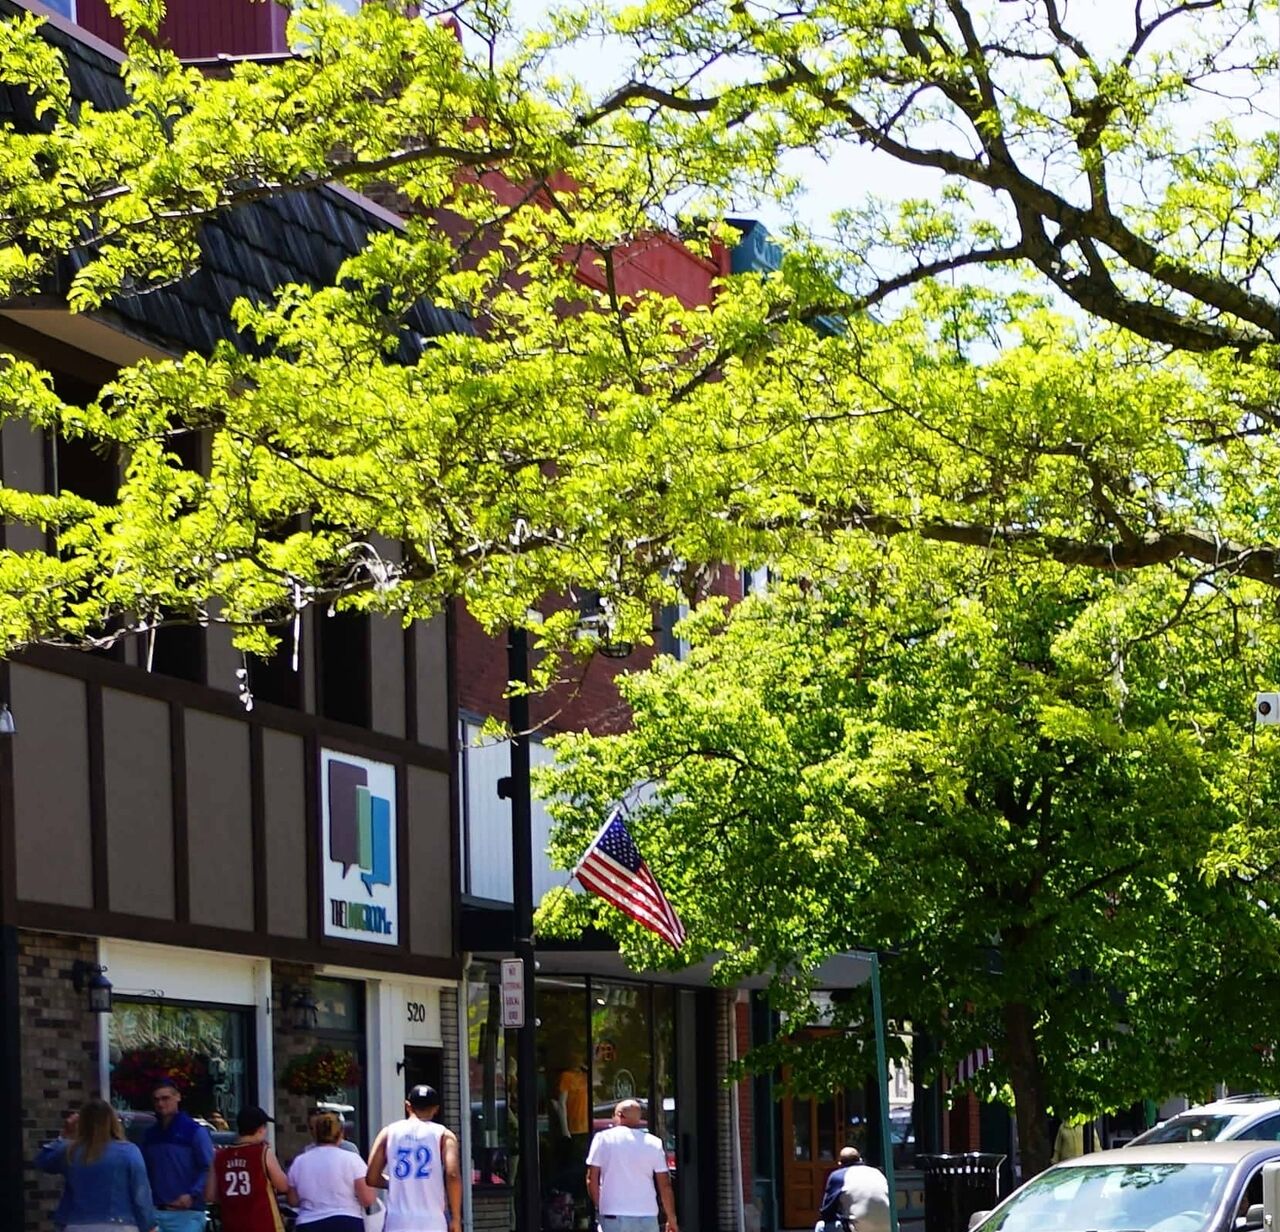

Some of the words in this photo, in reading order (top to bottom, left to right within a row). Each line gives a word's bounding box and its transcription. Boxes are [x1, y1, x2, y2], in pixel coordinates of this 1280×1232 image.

[407, 1001, 426, 1023] 520
[395, 1145, 432, 1180] 32
[224, 1170, 251, 1197] 23
